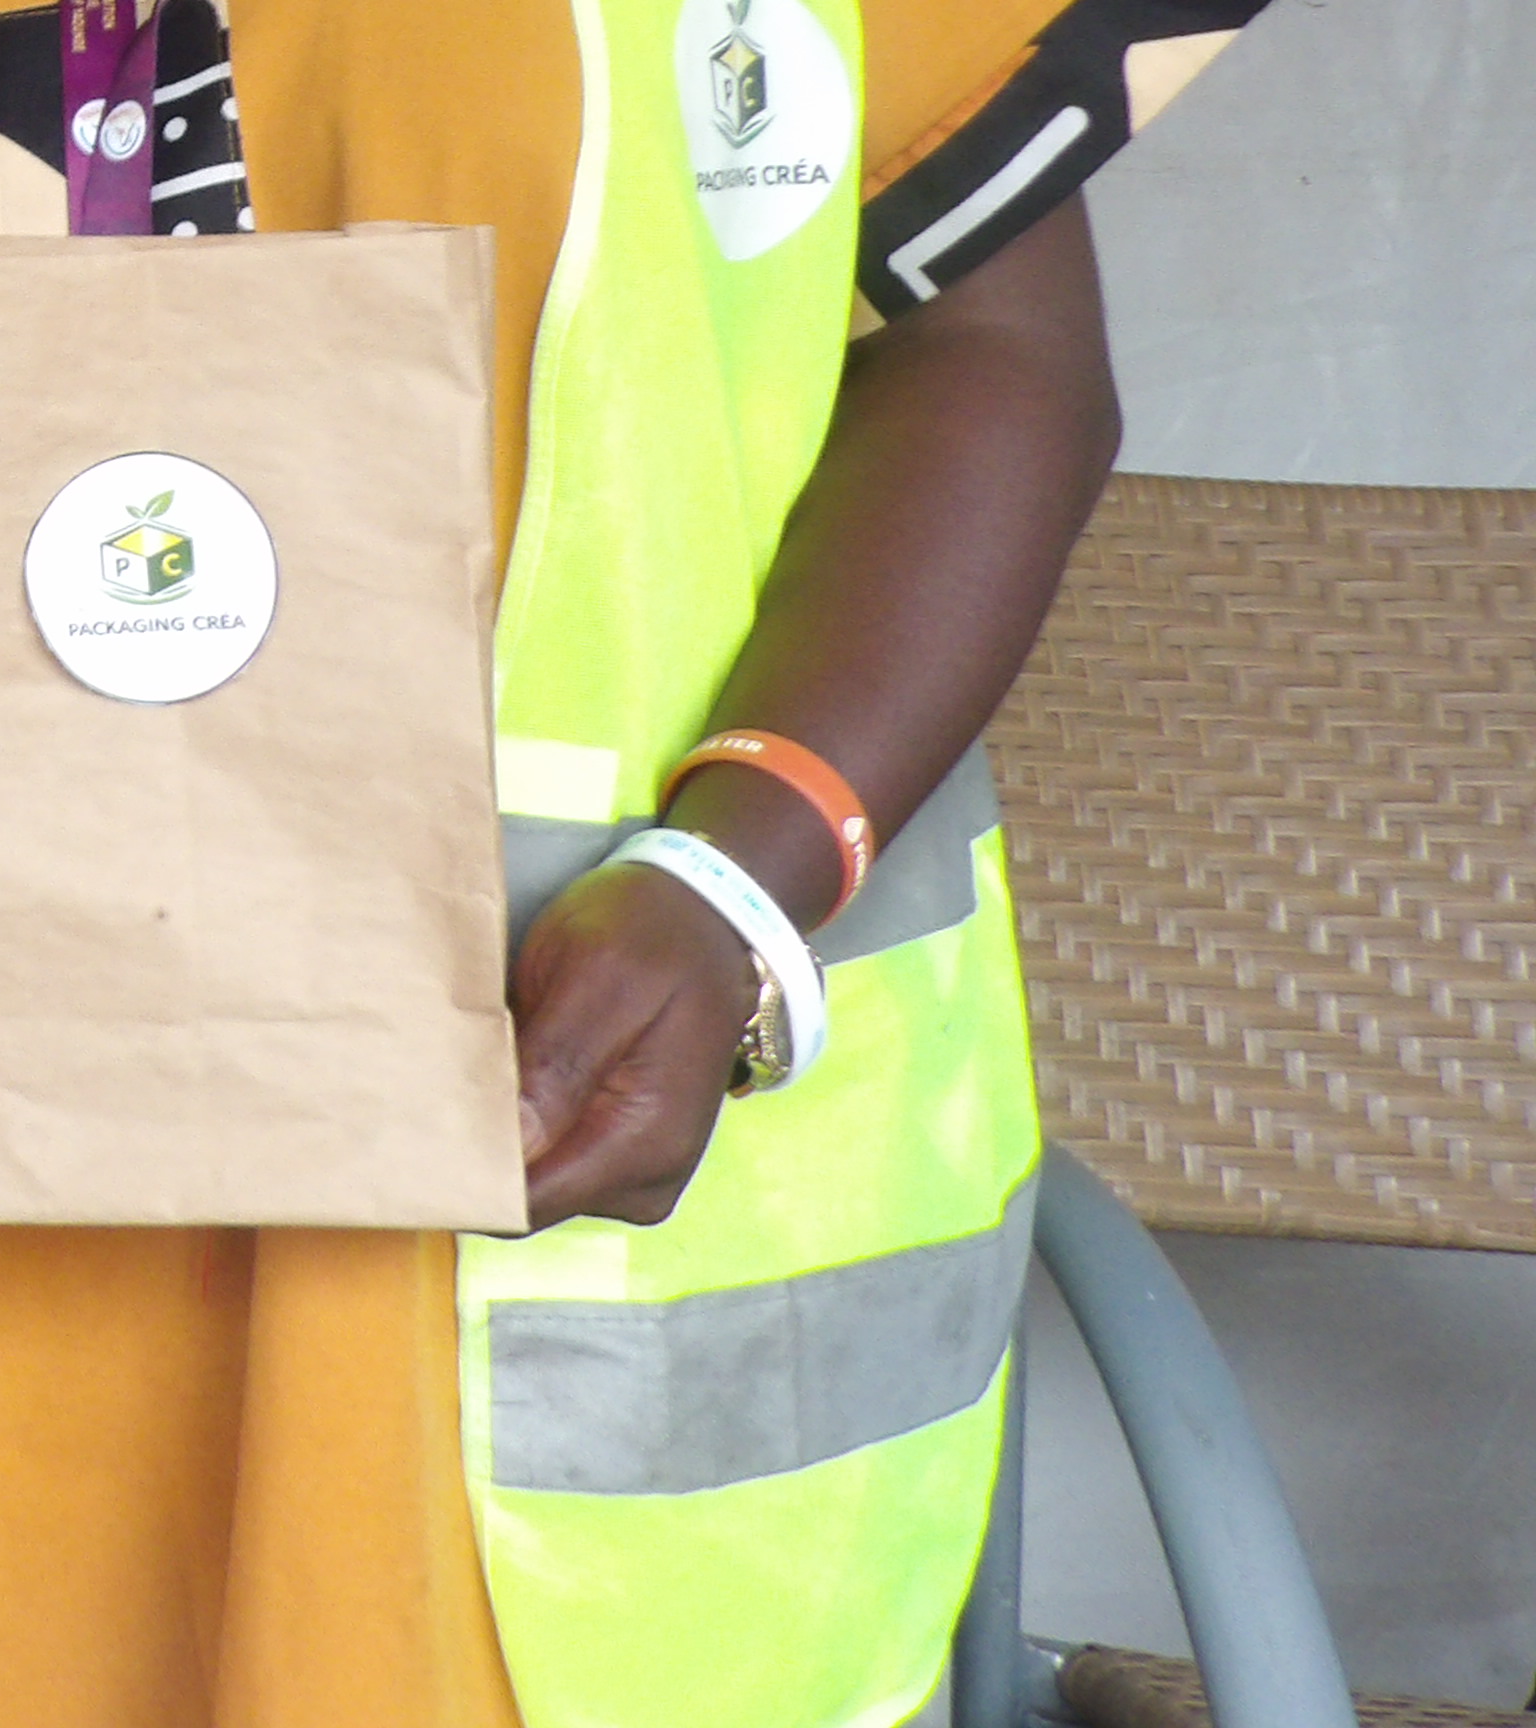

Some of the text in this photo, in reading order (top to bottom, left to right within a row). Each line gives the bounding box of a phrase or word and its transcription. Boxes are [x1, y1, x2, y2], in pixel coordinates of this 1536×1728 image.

[762, 158, 831, 186] CRÉA
[115, 553, 183, 577] P C
[68, 612, 247, 637] PACKAGING CRÉA
